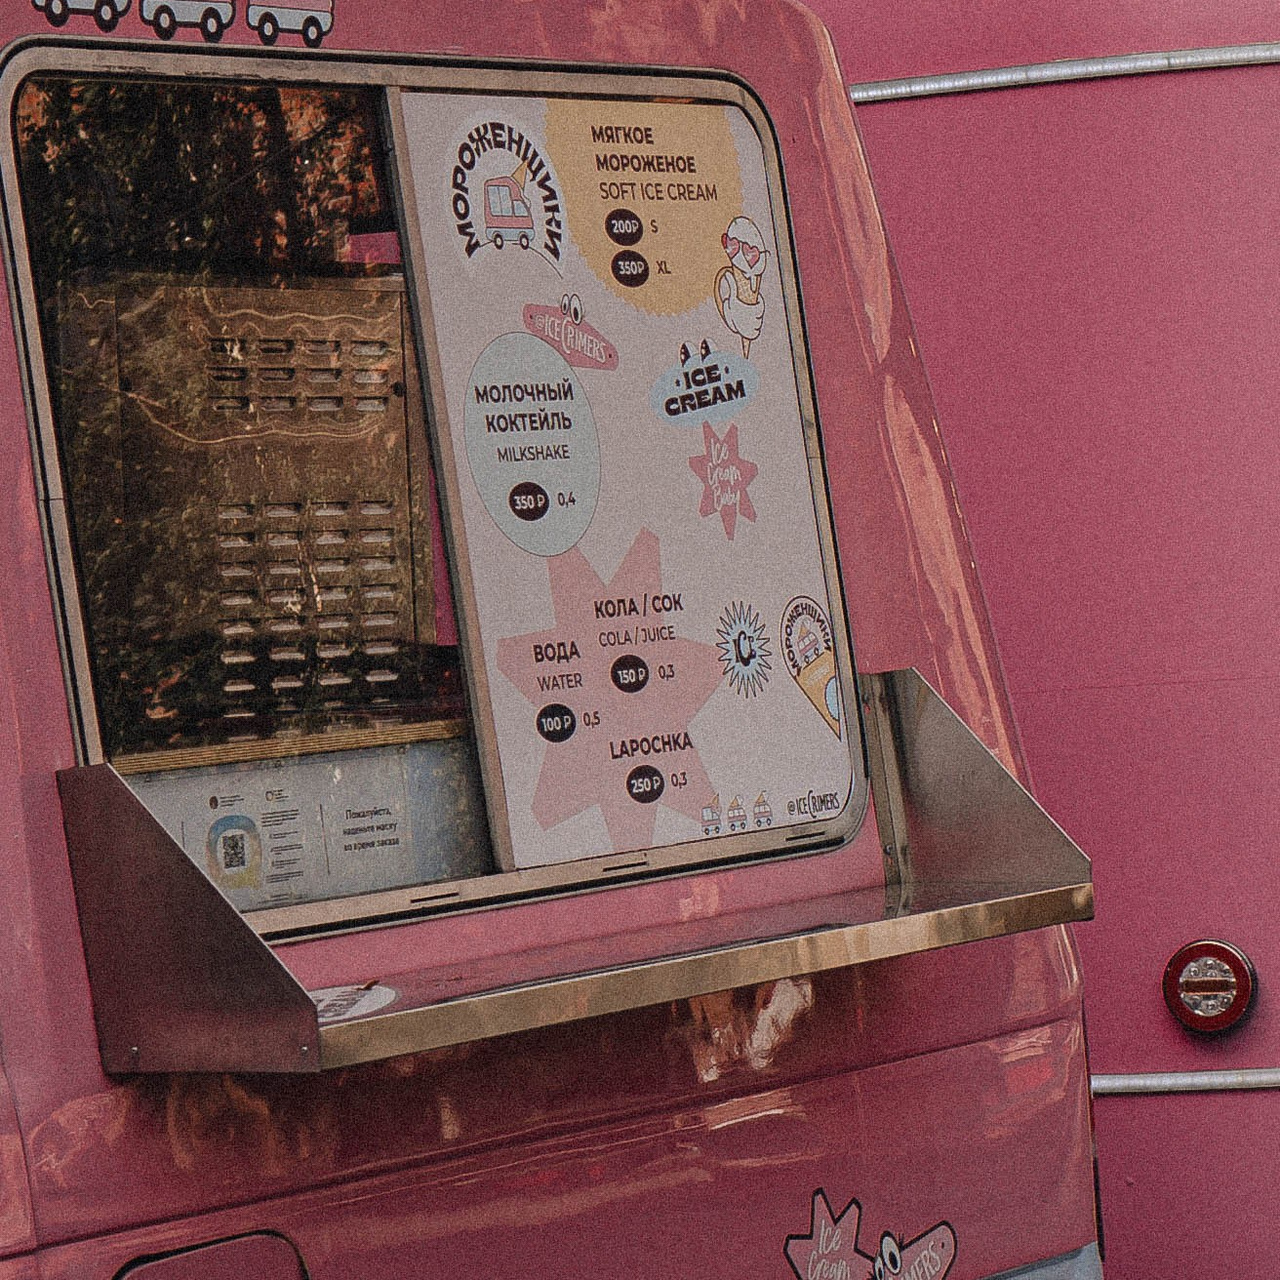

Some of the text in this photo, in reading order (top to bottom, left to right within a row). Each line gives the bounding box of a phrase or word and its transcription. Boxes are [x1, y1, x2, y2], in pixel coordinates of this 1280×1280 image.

[591, 125, 654, 145] МЯГКОЕ
[595, 154, 696, 173] МОРОЖЕНОЕ
[451, 122, 562, 261] МОРОЖЕНЩИКИ
[600, 182, 718, 201] SOFT ICE CREAM
[650, 219, 658, 234] S
[656, 261, 671, 274] XL
[474, 378, 574, 404] МОЛОЧНЫЙ
[665, 379, 746, 416] CREAM
[485, 408, 572, 433] КОКТЕЙЛЬ
[497, 444, 570, 462] MILKSHAKE
[557, 491, 576, 508] 0,4
[594, 598, 639, 619] КОЛА
[651, 593, 684, 613] СОК
[599, 630, 632, 647] COLA
[641, 625, 676, 643] JUICE
[533, 640, 581, 664] ВОДА
[658, 664, 675, 680] 0,3
[537, 673, 583, 691] WATER
[583, 711, 601, 729] 0,5
[610, 732, 694, 759] LAPOCHKA
[671, 772, 687, 789] 0,3
[819, 1219, 843, 1255] Ice
